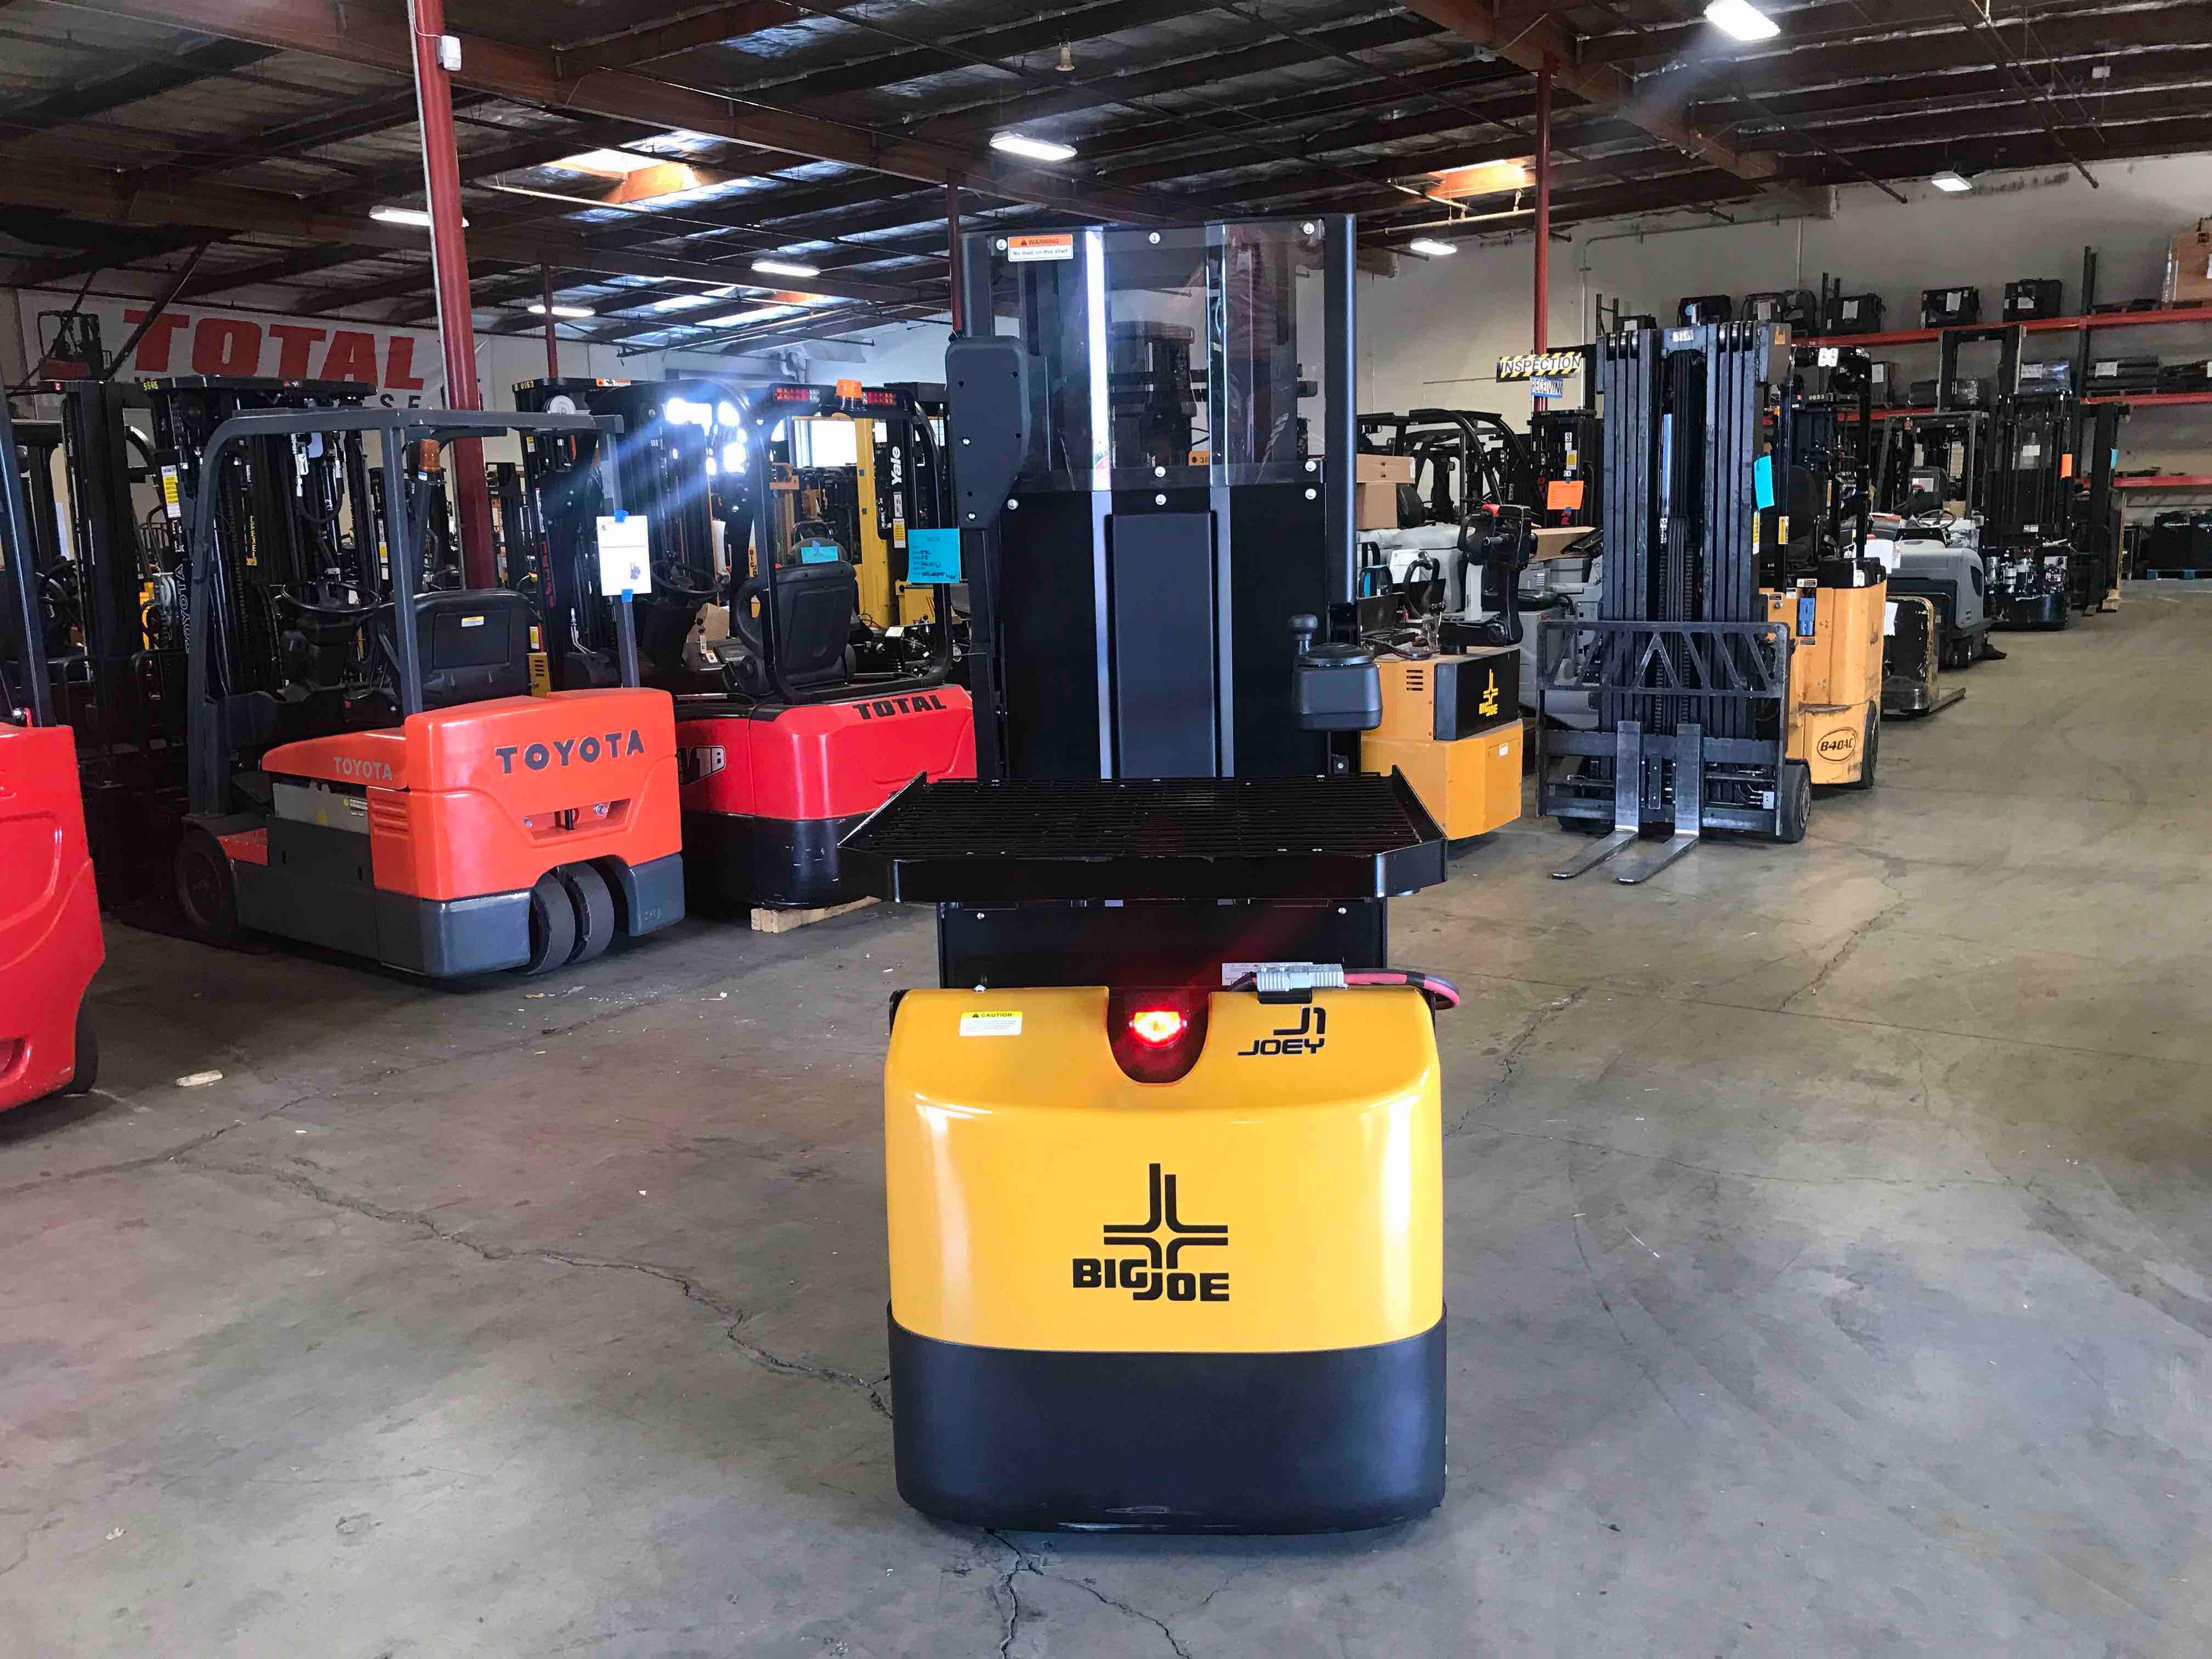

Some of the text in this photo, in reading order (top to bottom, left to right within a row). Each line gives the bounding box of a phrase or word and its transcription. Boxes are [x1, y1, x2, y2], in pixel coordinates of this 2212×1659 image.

[123, 309, 424, 391] TOTAL
[1501, 357, 1581, 373] INSPECTION
[891, 445, 903, 486] Yale
[853, 694, 948, 720] TOTAL
[494, 729, 646, 774] TOYOTA
[333, 756, 393, 780] TOYOTA
[1237, 1038, 1325, 1056] JOEY
